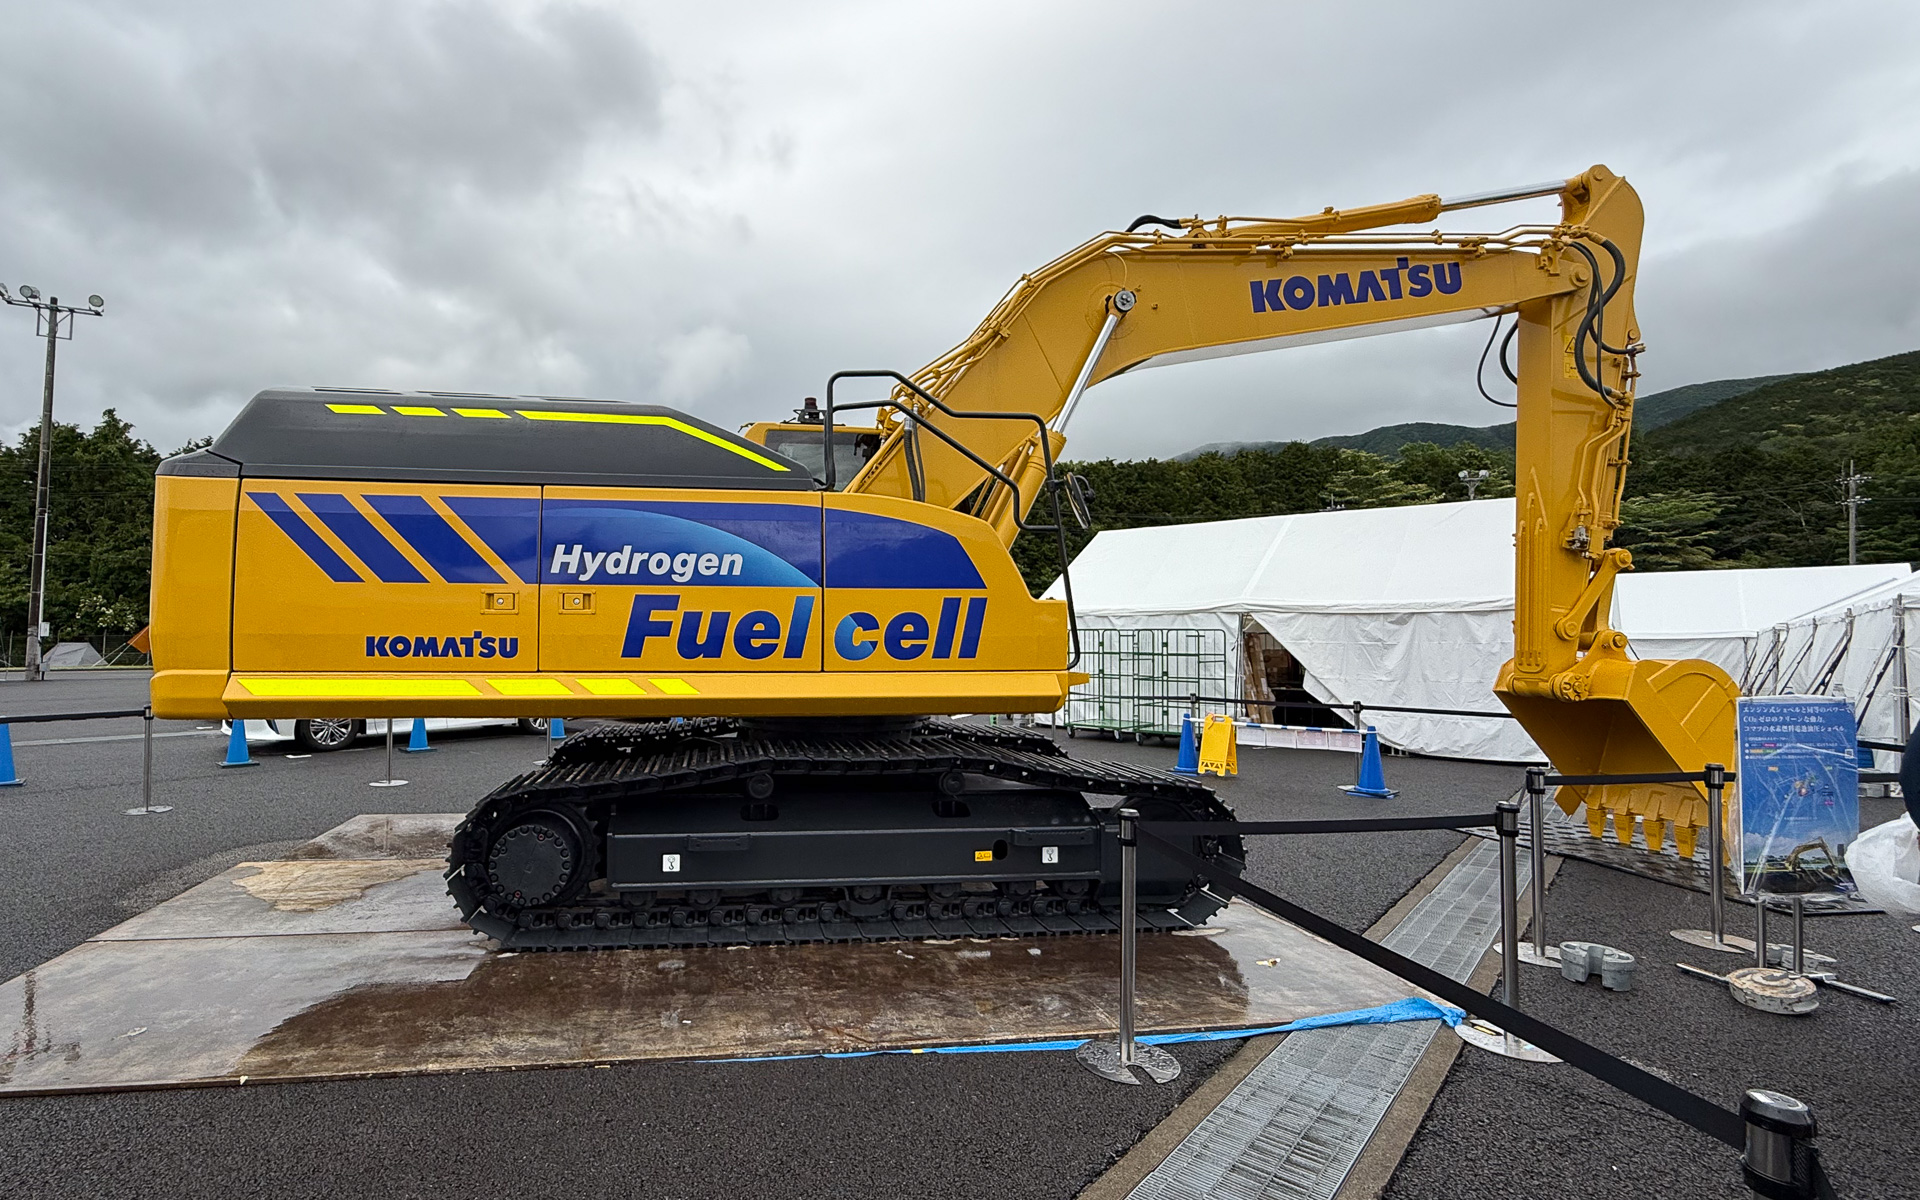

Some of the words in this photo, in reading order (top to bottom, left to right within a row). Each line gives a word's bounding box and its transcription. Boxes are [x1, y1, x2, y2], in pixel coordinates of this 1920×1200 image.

[1250, 257, 1462, 313] KOMATSU
[550, 544, 743, 582] Hydrogen
[365, 630, 518, 658] KOMATSU
[620, 594, 815, 660] Fuel
[834, 597, 988, 661] cell
